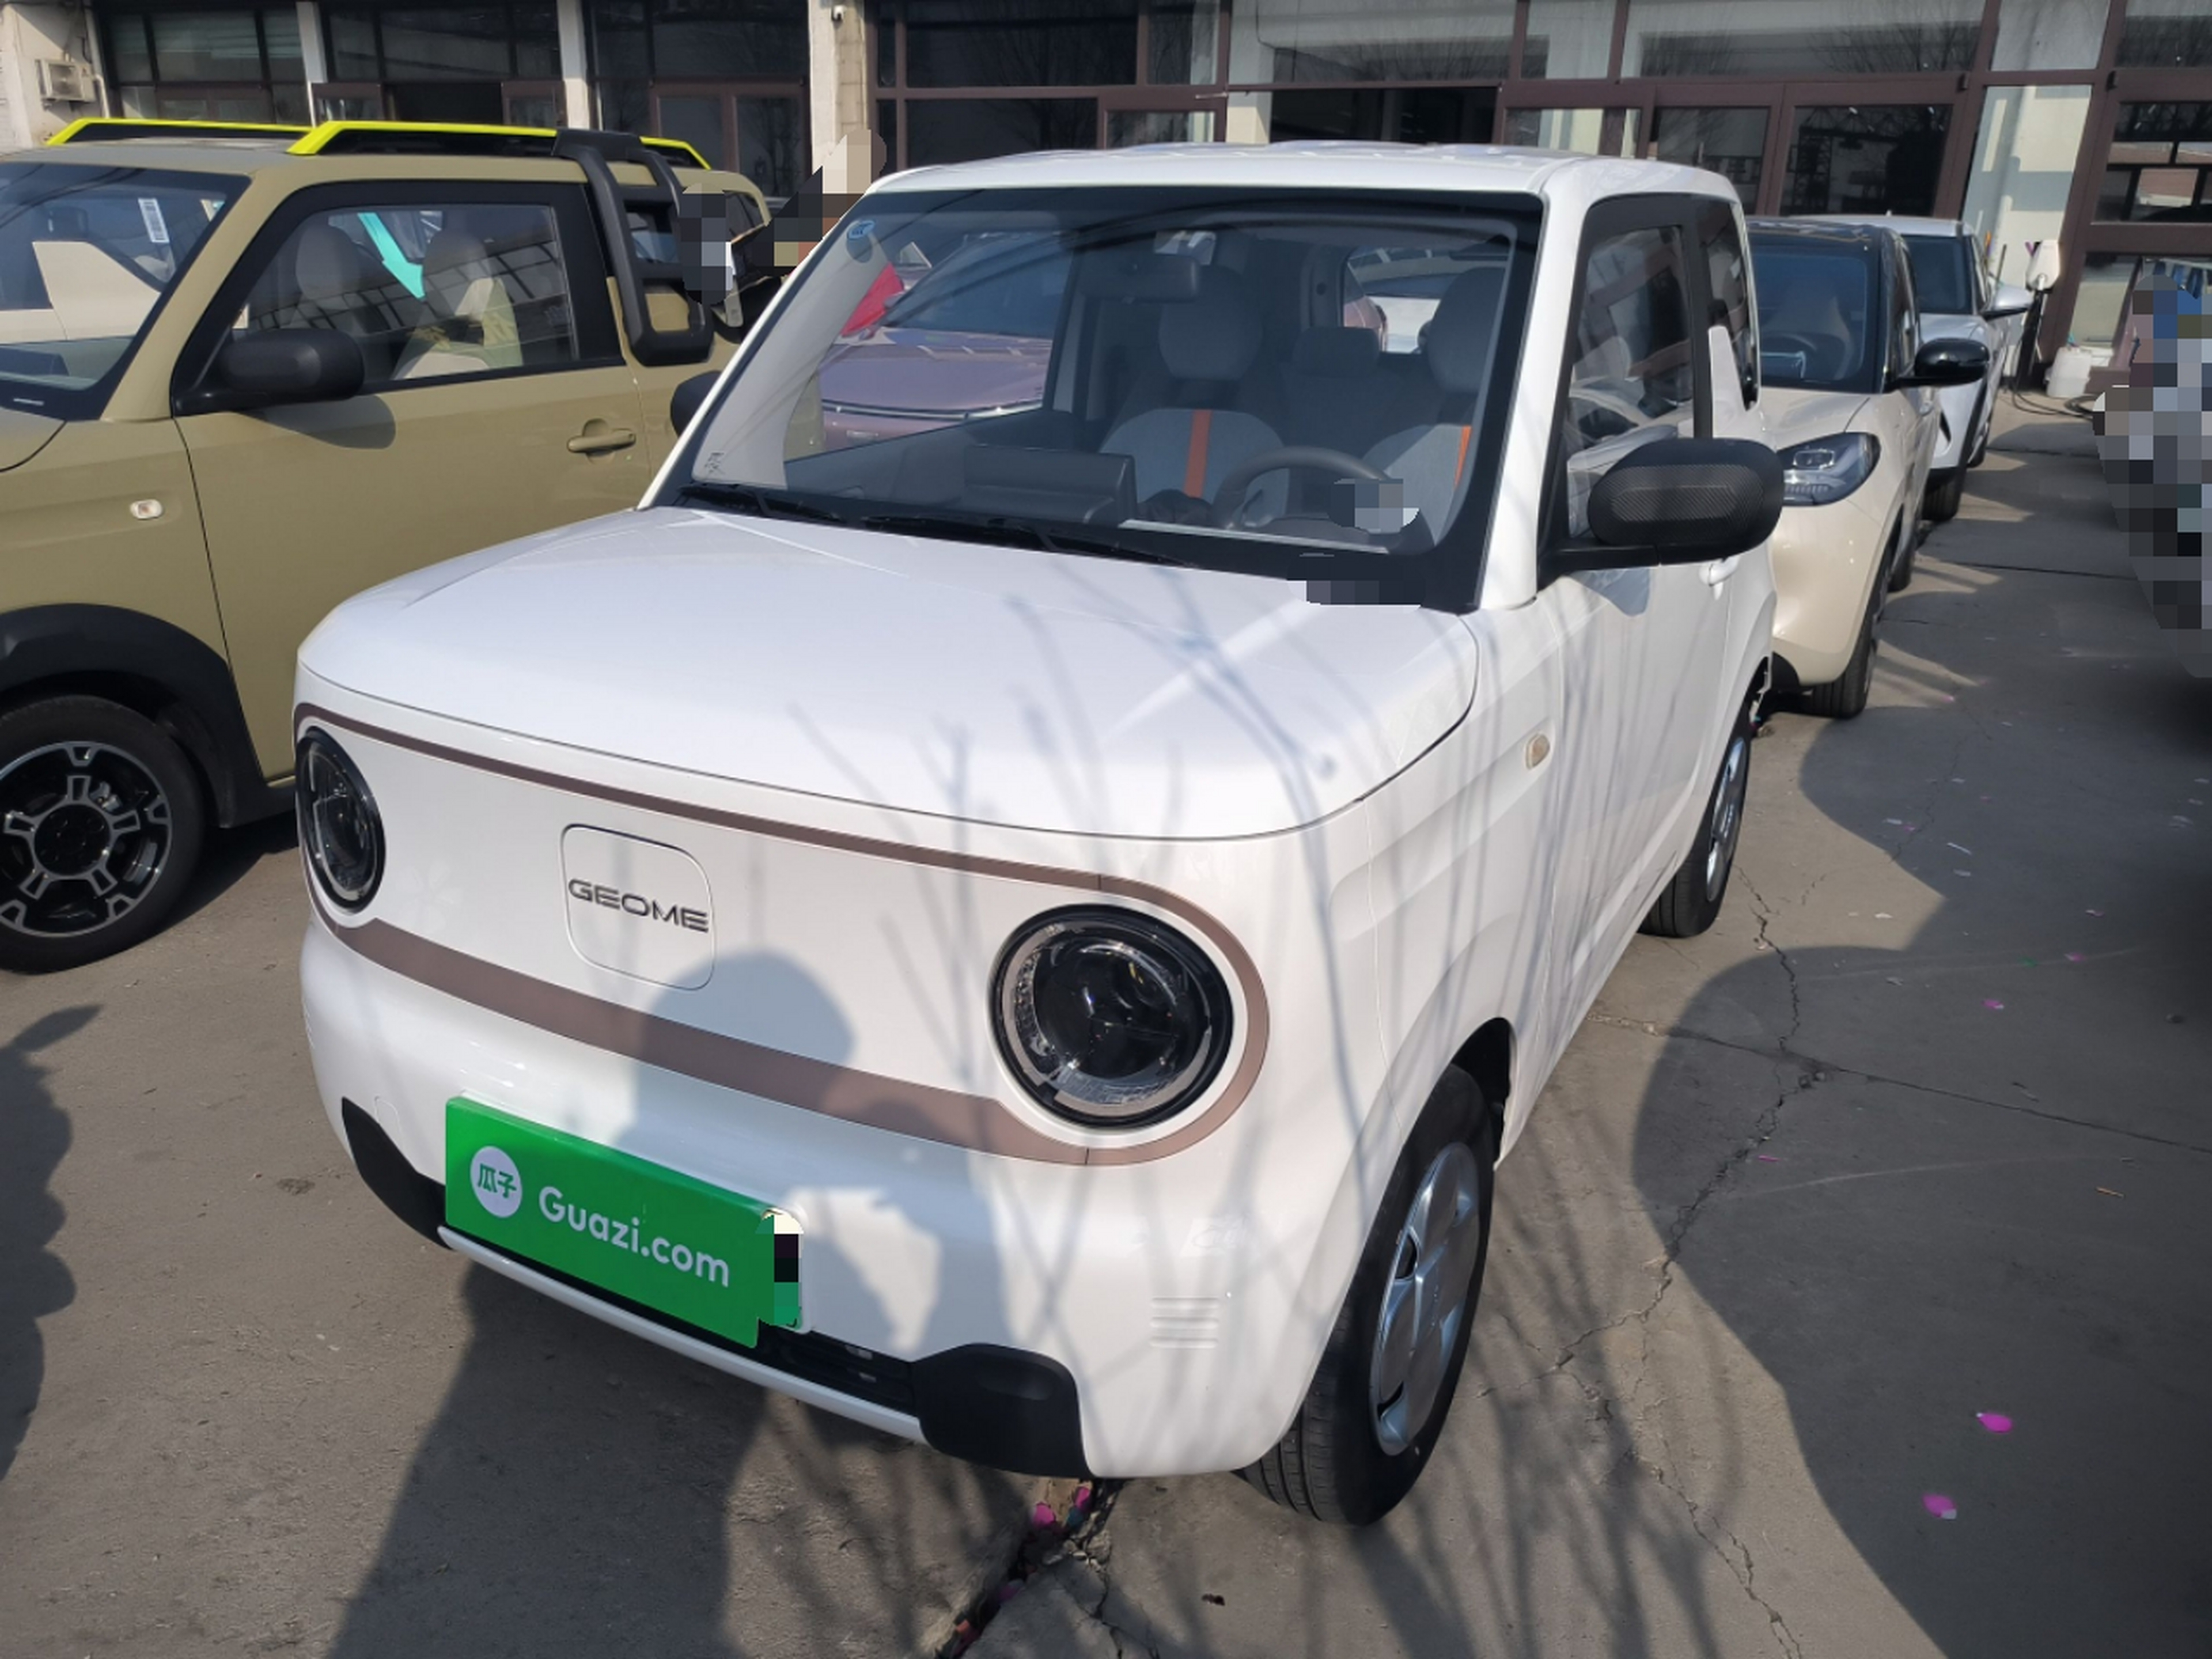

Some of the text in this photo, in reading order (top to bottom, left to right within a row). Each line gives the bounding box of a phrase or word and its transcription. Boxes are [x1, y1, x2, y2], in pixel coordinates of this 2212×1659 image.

[568, 878, 709, 933] GEOME
[478, 1162, 517, 1199] 瓜子
[539, 1185, 730, 1288] Guazi.com
